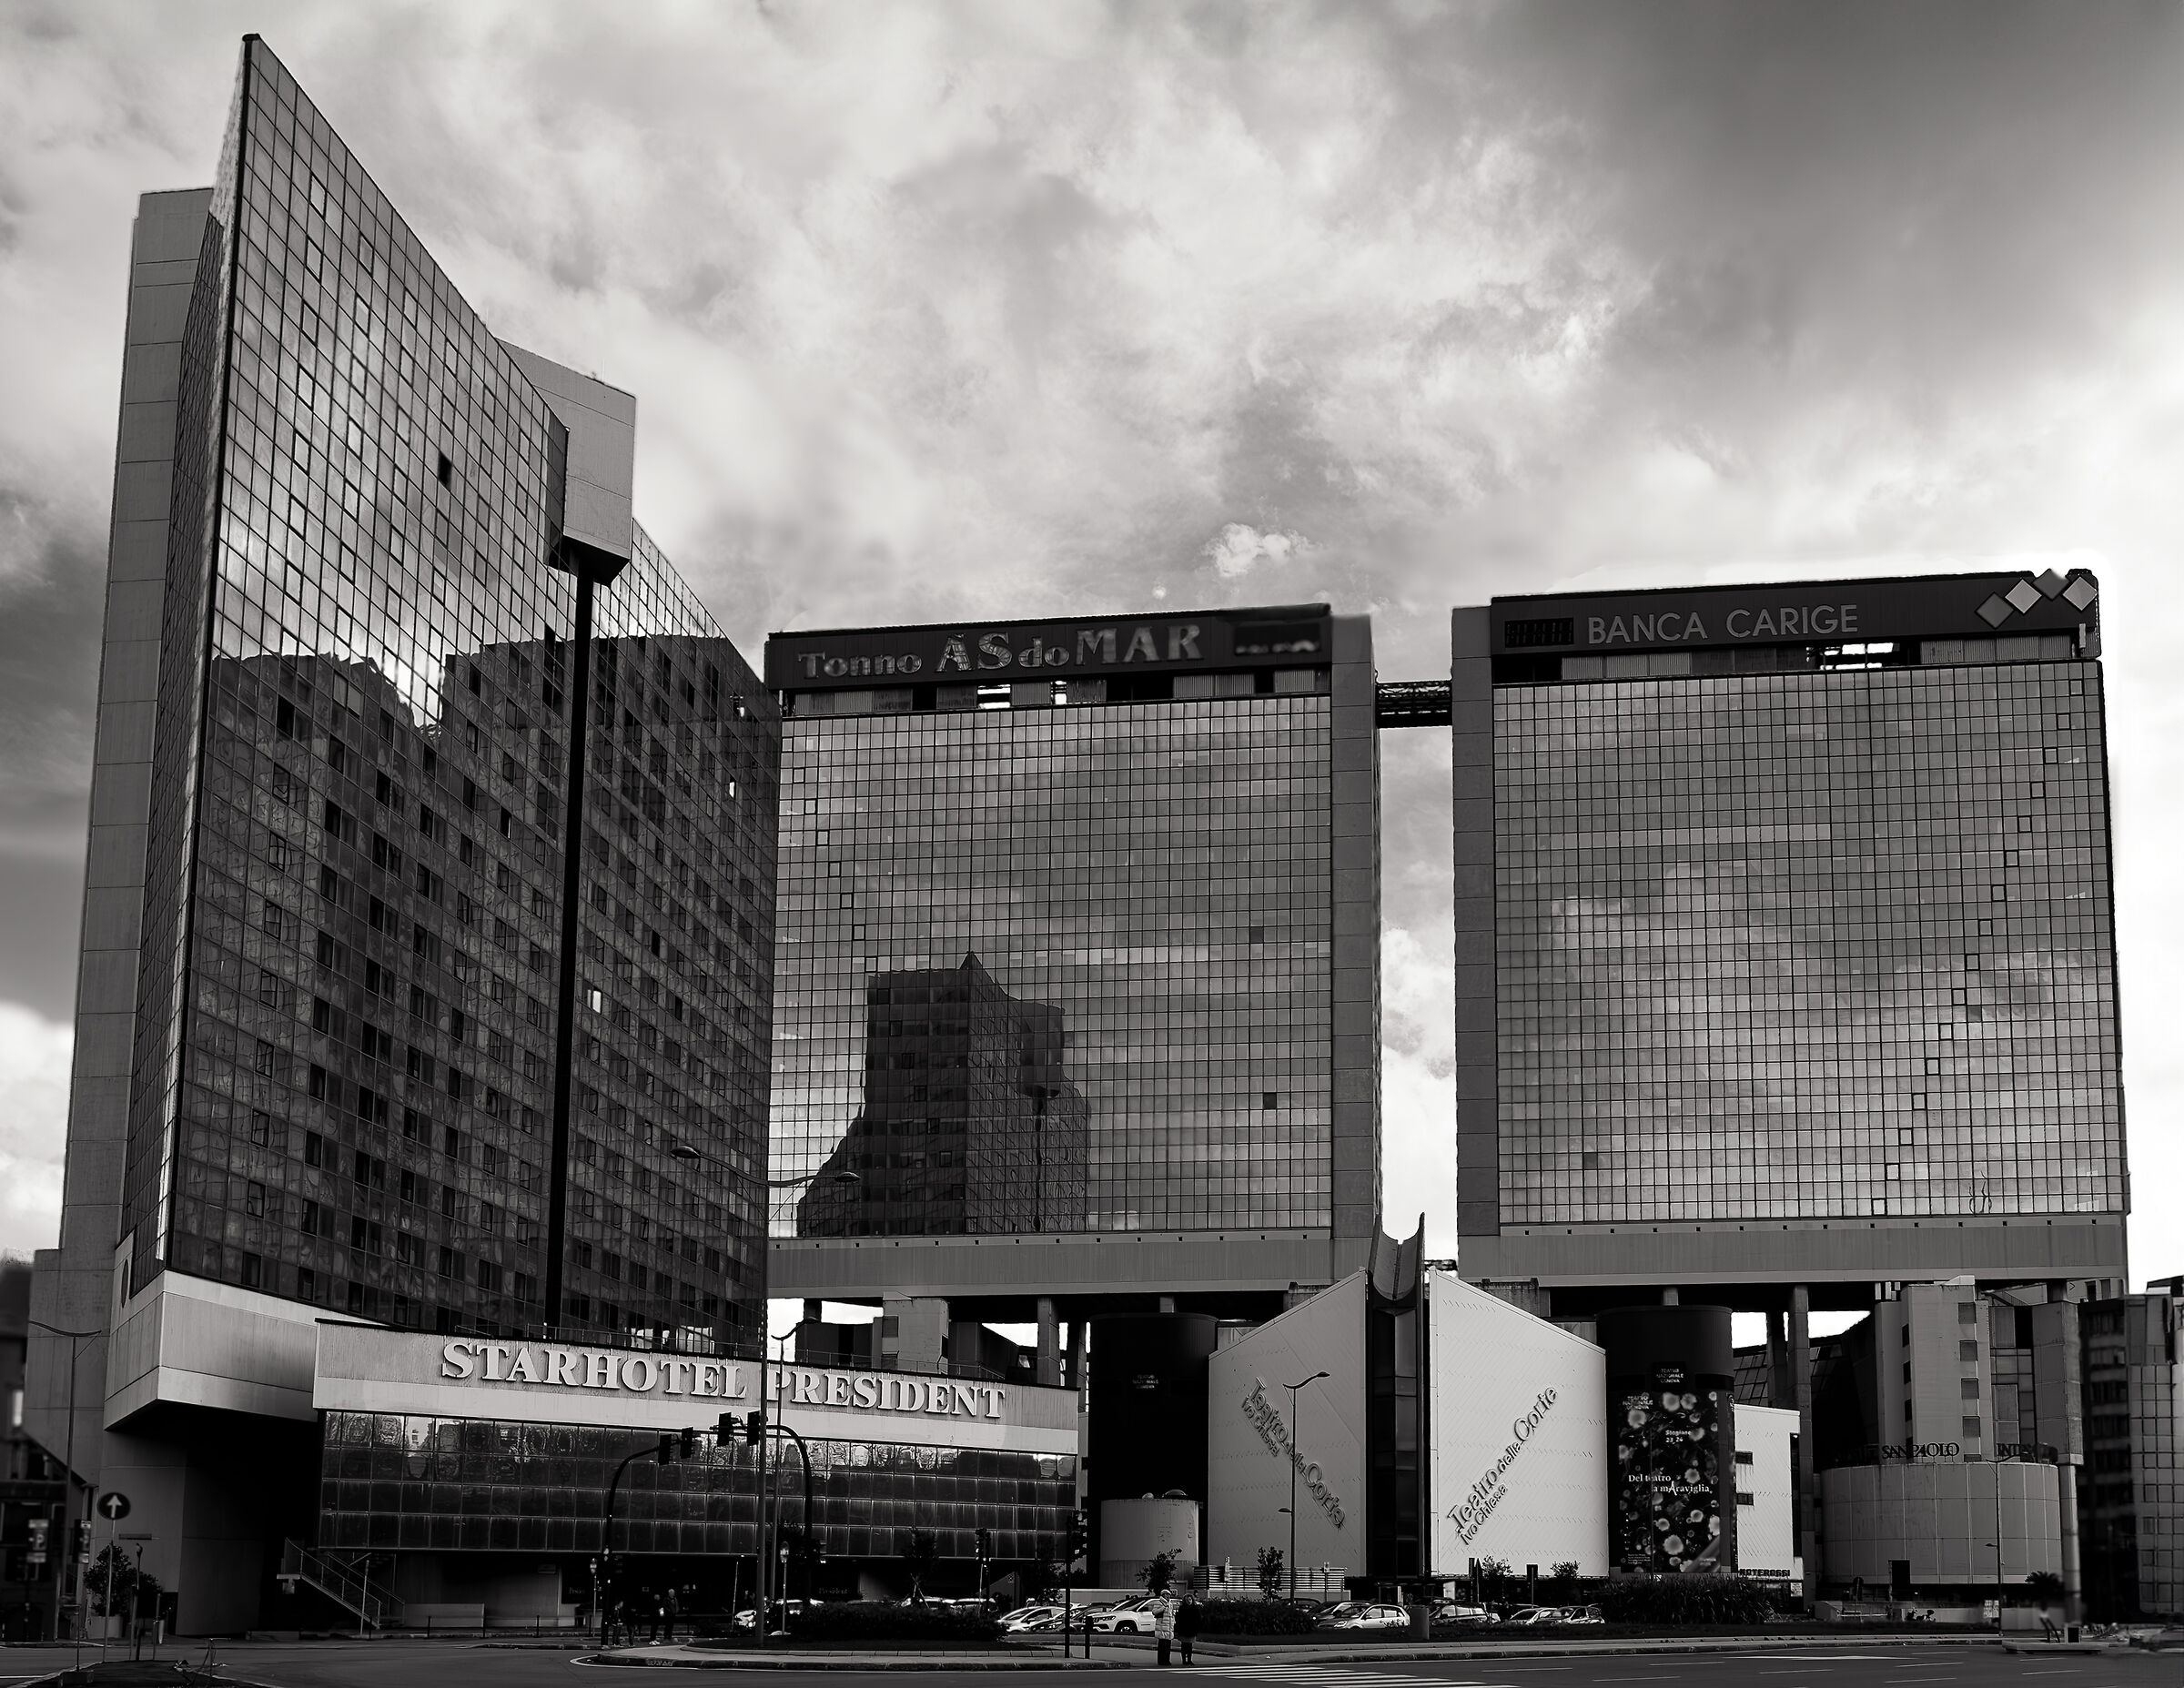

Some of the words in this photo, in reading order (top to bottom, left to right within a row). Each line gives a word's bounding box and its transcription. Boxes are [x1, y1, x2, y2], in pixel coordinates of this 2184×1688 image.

[797, 650, 922, 680] Tonno
[1017, 635, 1069, 668] do
[1077, 622, 1204, 666] MAR
[1587, 611, 1708, 645] BANCA
[1725, 603, 1859, 638] CARIGE
[441, 1341, 747, 1400] STARHOTEL
[766, 1367, 1006, 1420] PRESIDENT
[1248, 1375, 1289, 1443] Teatro
[1304, 1462, 1346, 1528] Corte
[1446, 1468, 1498, 1530] Teatro
[1496, 1440, 1522, 1474] della
[1513, 1385, 1559, 1441] Corte
[1628, 1473, 1643, 1482] Del
[1475, 1483, 1509, 1528] Chiesa
